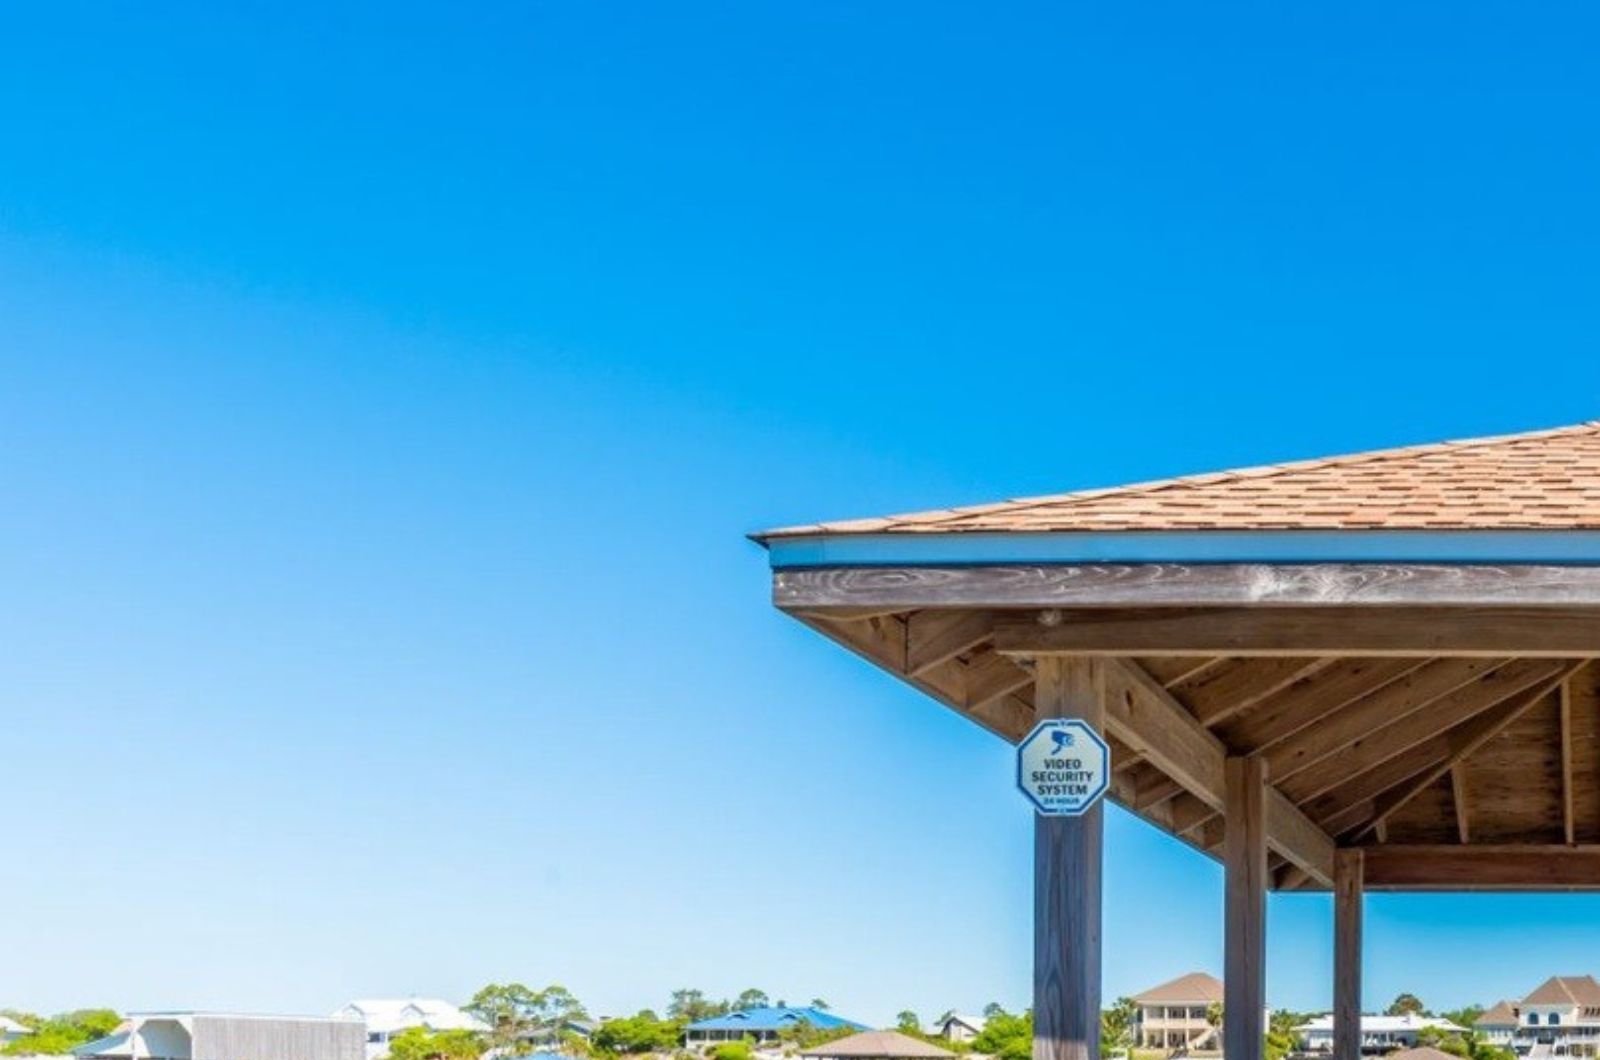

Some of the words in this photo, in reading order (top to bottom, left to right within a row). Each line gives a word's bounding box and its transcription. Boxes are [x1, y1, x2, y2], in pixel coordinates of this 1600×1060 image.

[1044, 759, 1082, 769] VIDEO
[1032, 771, 1094, 782] SECURITY
[1038, 785, 1087, 795] SYSTEM
